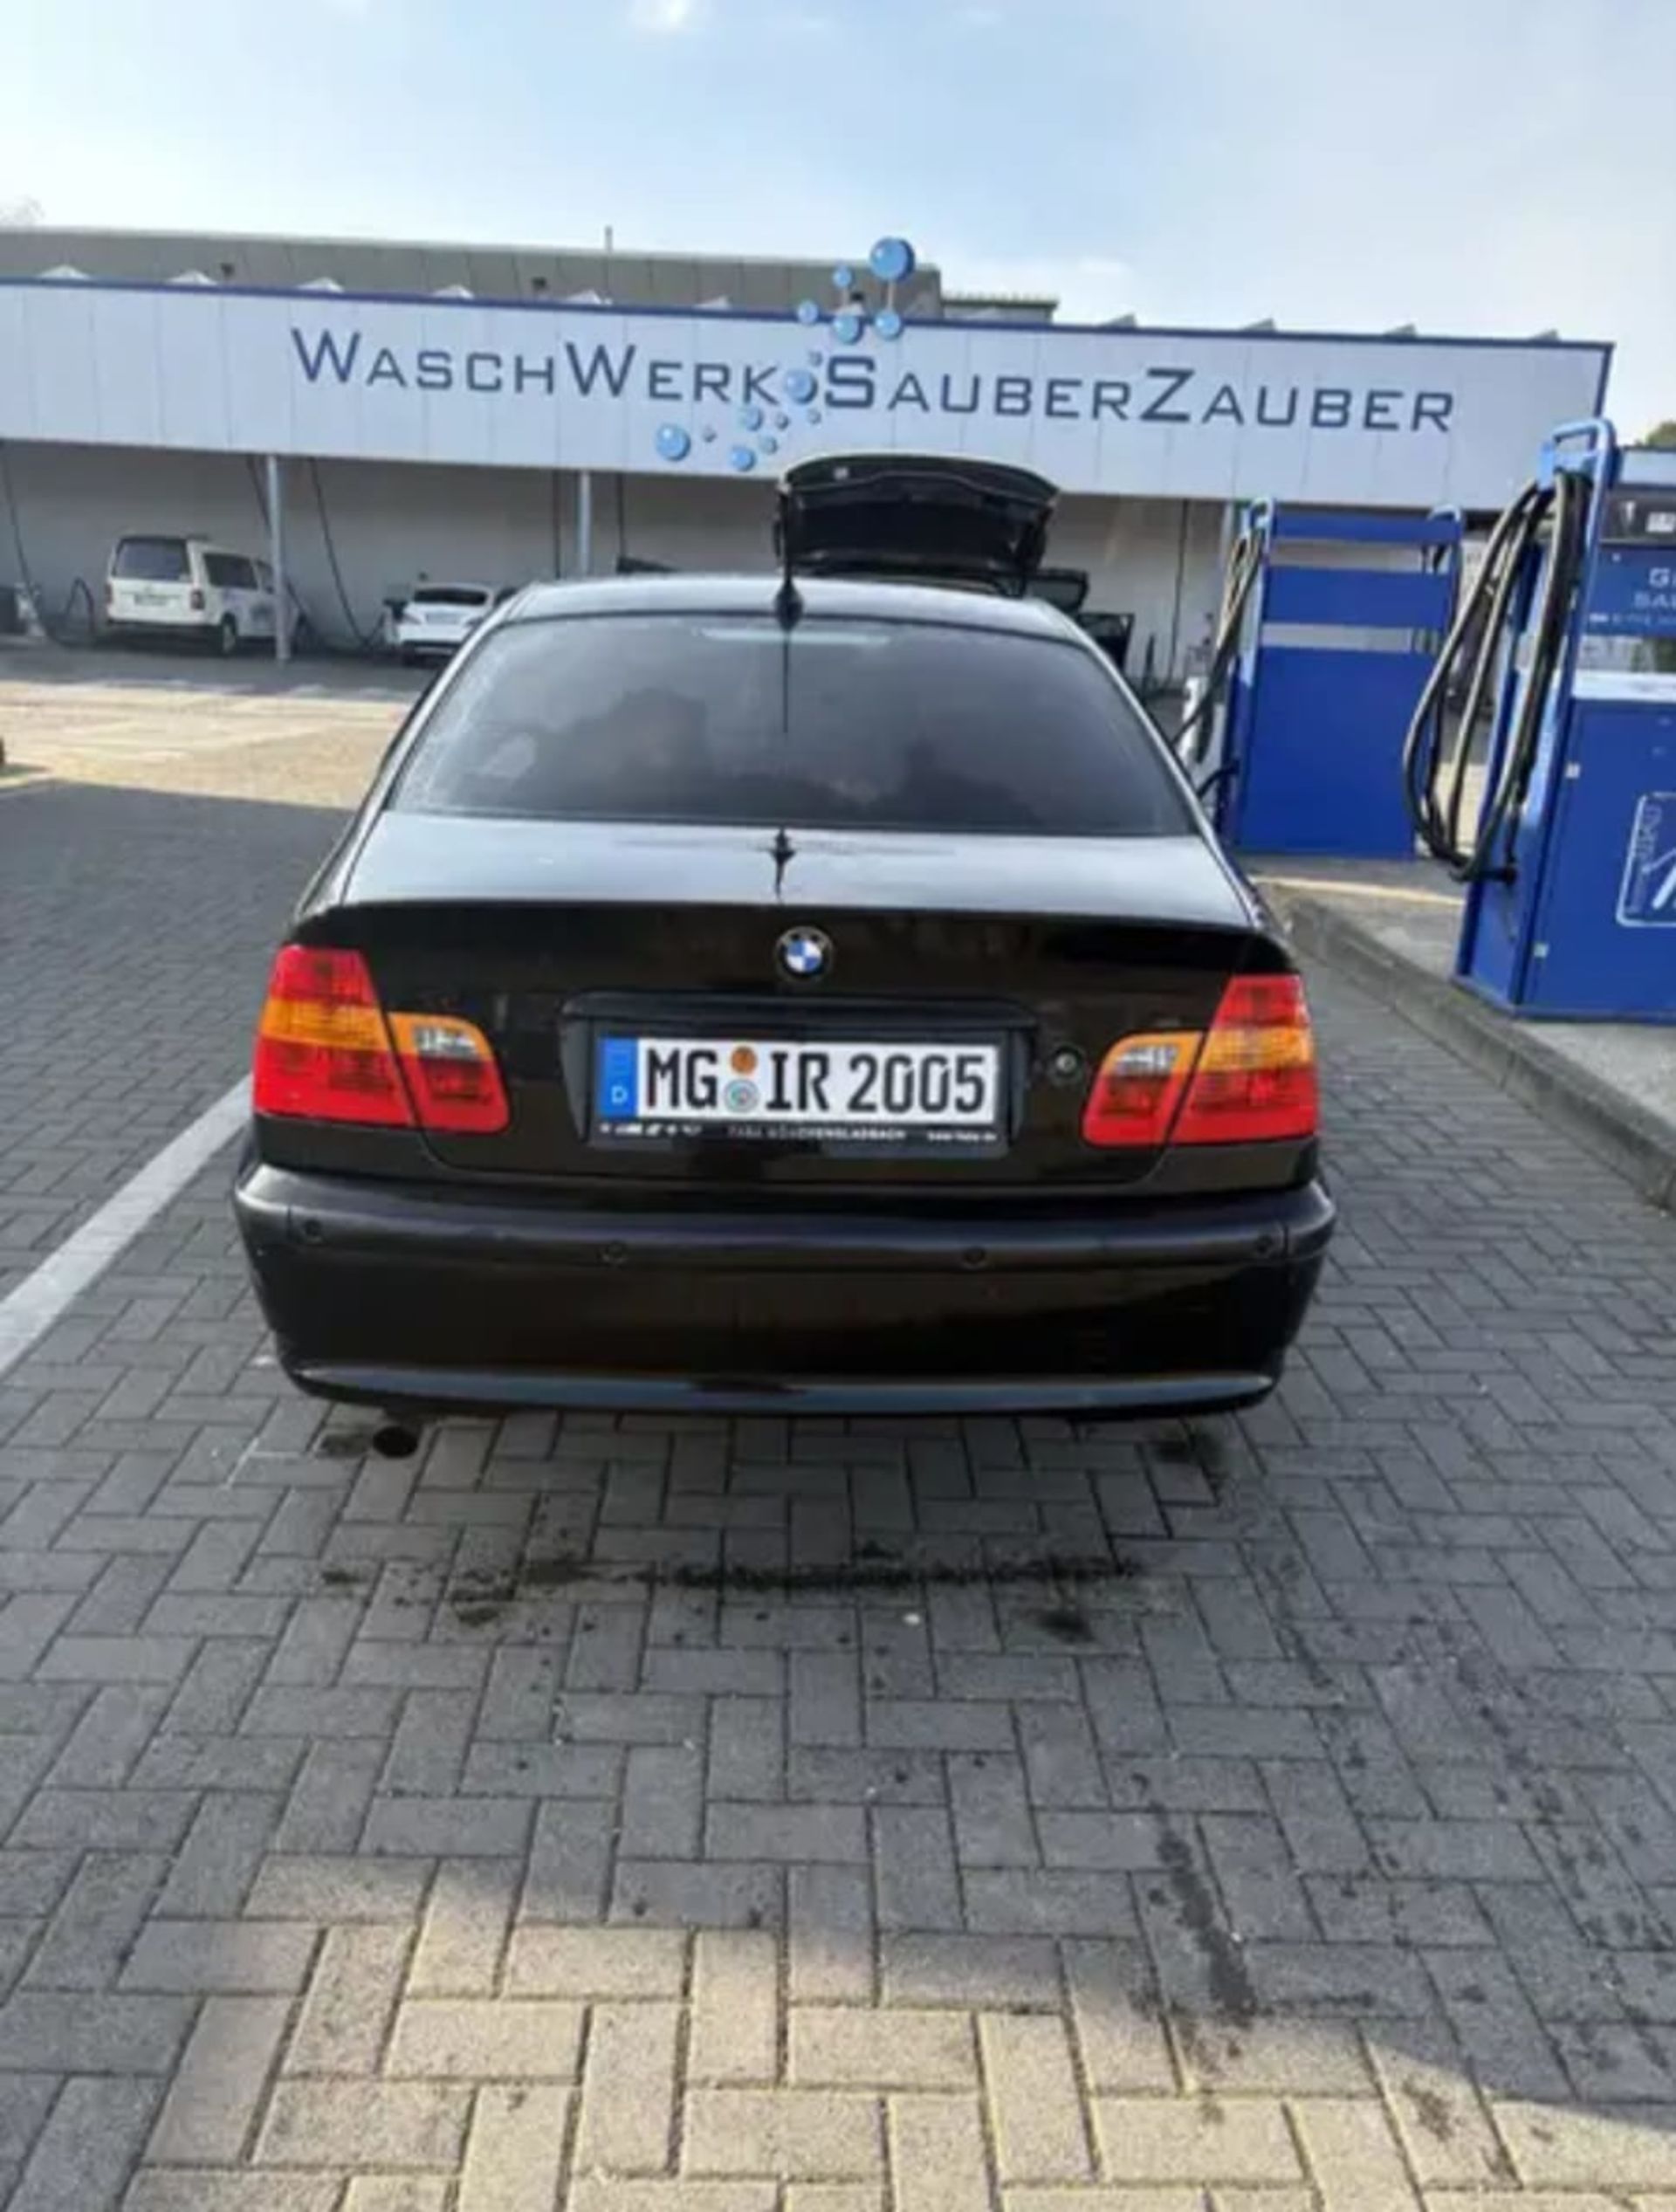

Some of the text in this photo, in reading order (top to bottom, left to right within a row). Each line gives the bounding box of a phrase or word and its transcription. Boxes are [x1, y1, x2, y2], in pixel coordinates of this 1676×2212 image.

[647, 1048, 986, 1114] MG IR 2005
